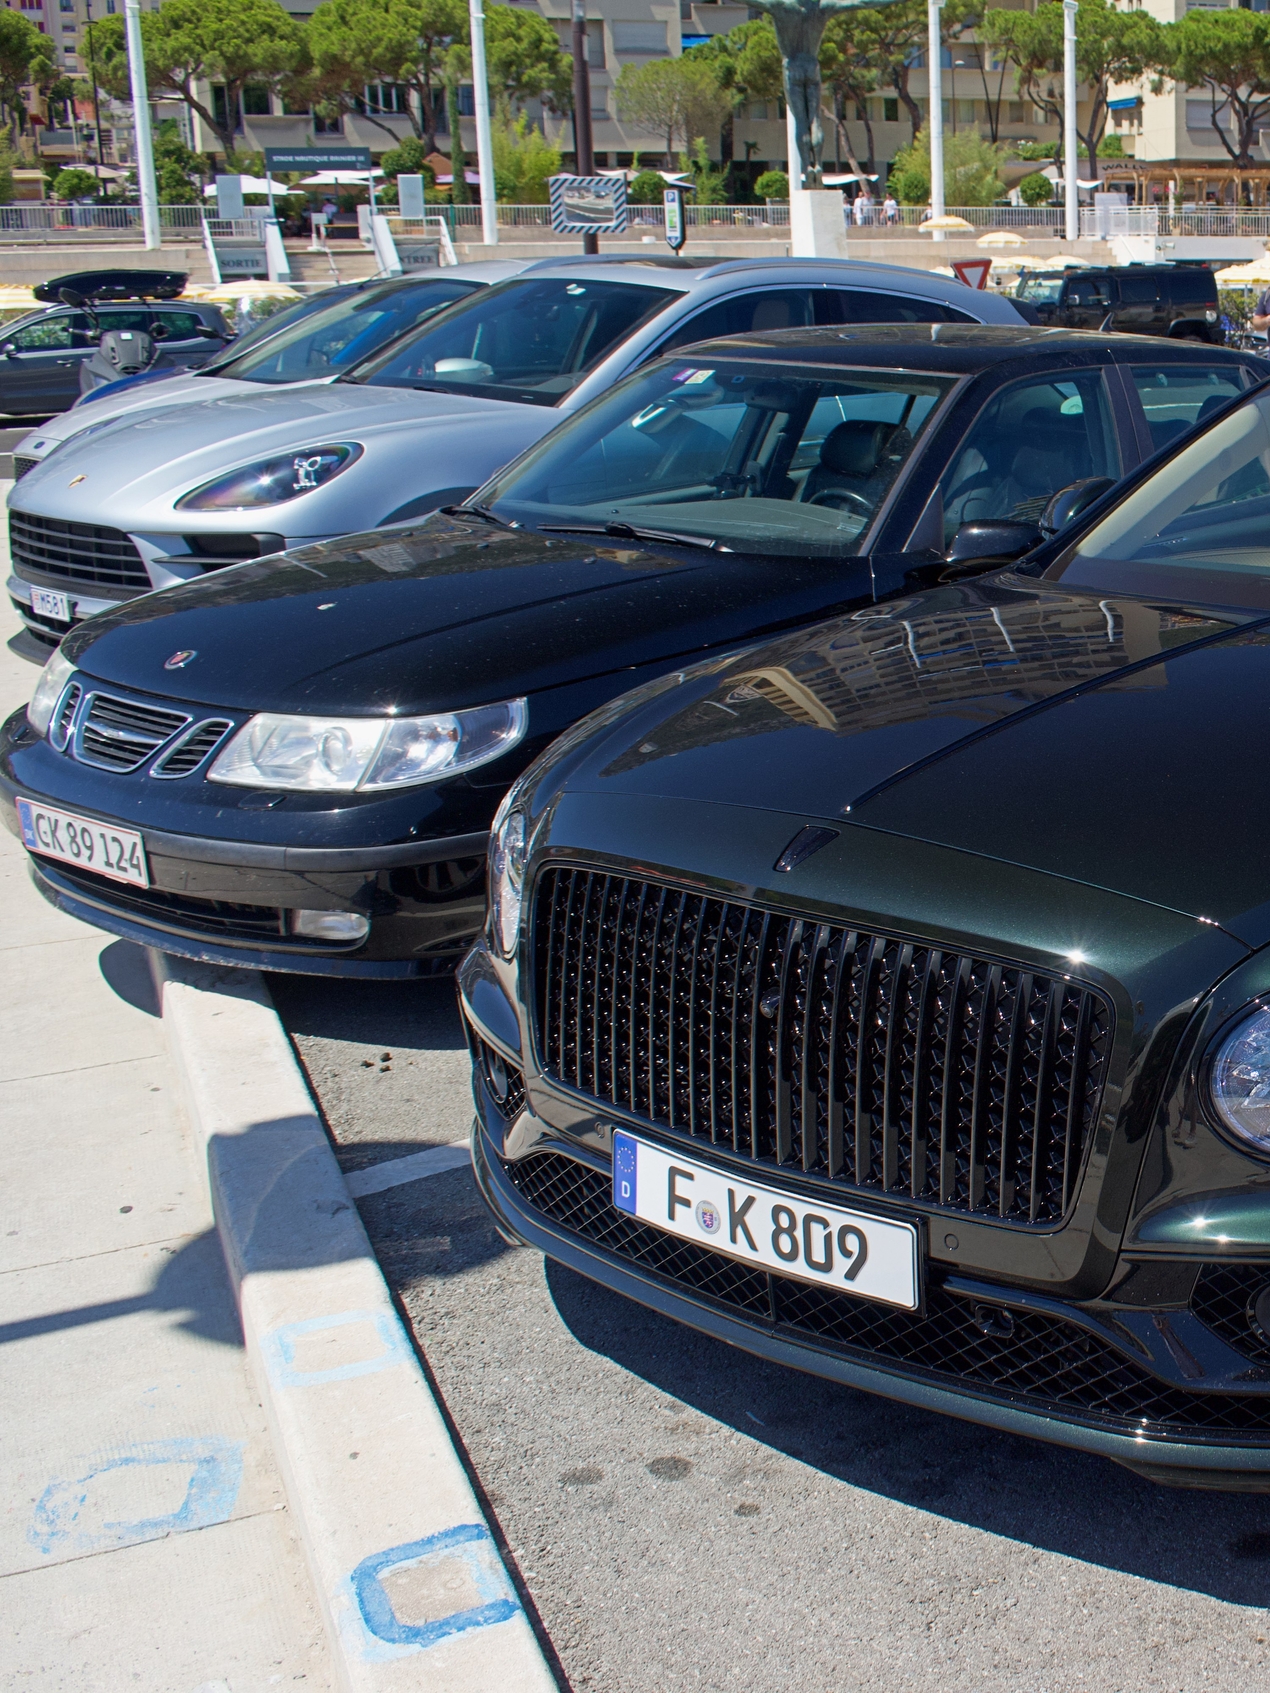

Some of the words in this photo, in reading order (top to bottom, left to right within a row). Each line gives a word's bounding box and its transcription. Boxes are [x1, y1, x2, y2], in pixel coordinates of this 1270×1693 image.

[221, 259, 262, 268] SORTIE
[36, 813, 65, 853] CK
[66, 822, 95, 863] 89
[100, 833, 143, 878] 124
[622, 1181, 630, 1198] D
[667, 1166, 695, 1221] F
[728, 1188, 759, 1252] K
[771, 1204, 868, 1282] 809
